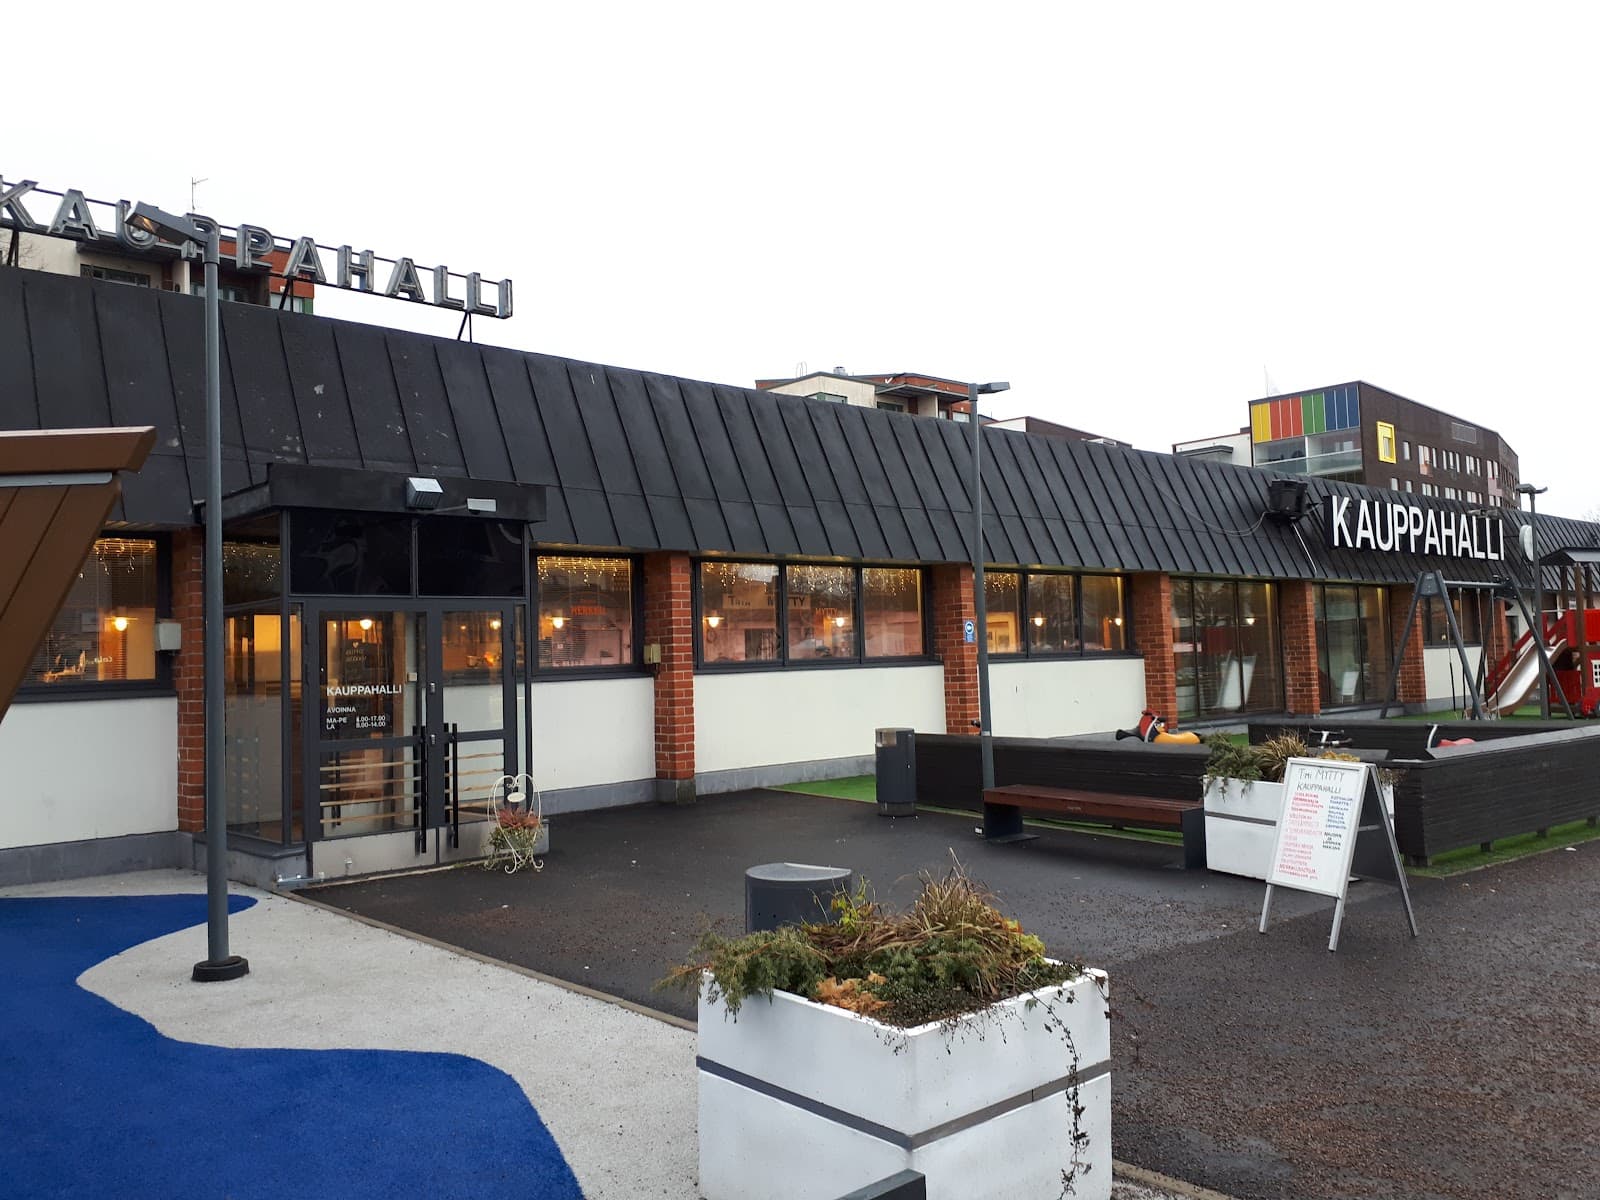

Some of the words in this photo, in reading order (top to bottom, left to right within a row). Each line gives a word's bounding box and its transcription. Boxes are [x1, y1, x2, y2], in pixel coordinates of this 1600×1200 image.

[1332, 495, 1504, 561] KAUPPAHALLI
[326, 685, 402, 696] KAUPPAHALLI
[1296, 782, 1341, 794] KAUPPAHALLI
